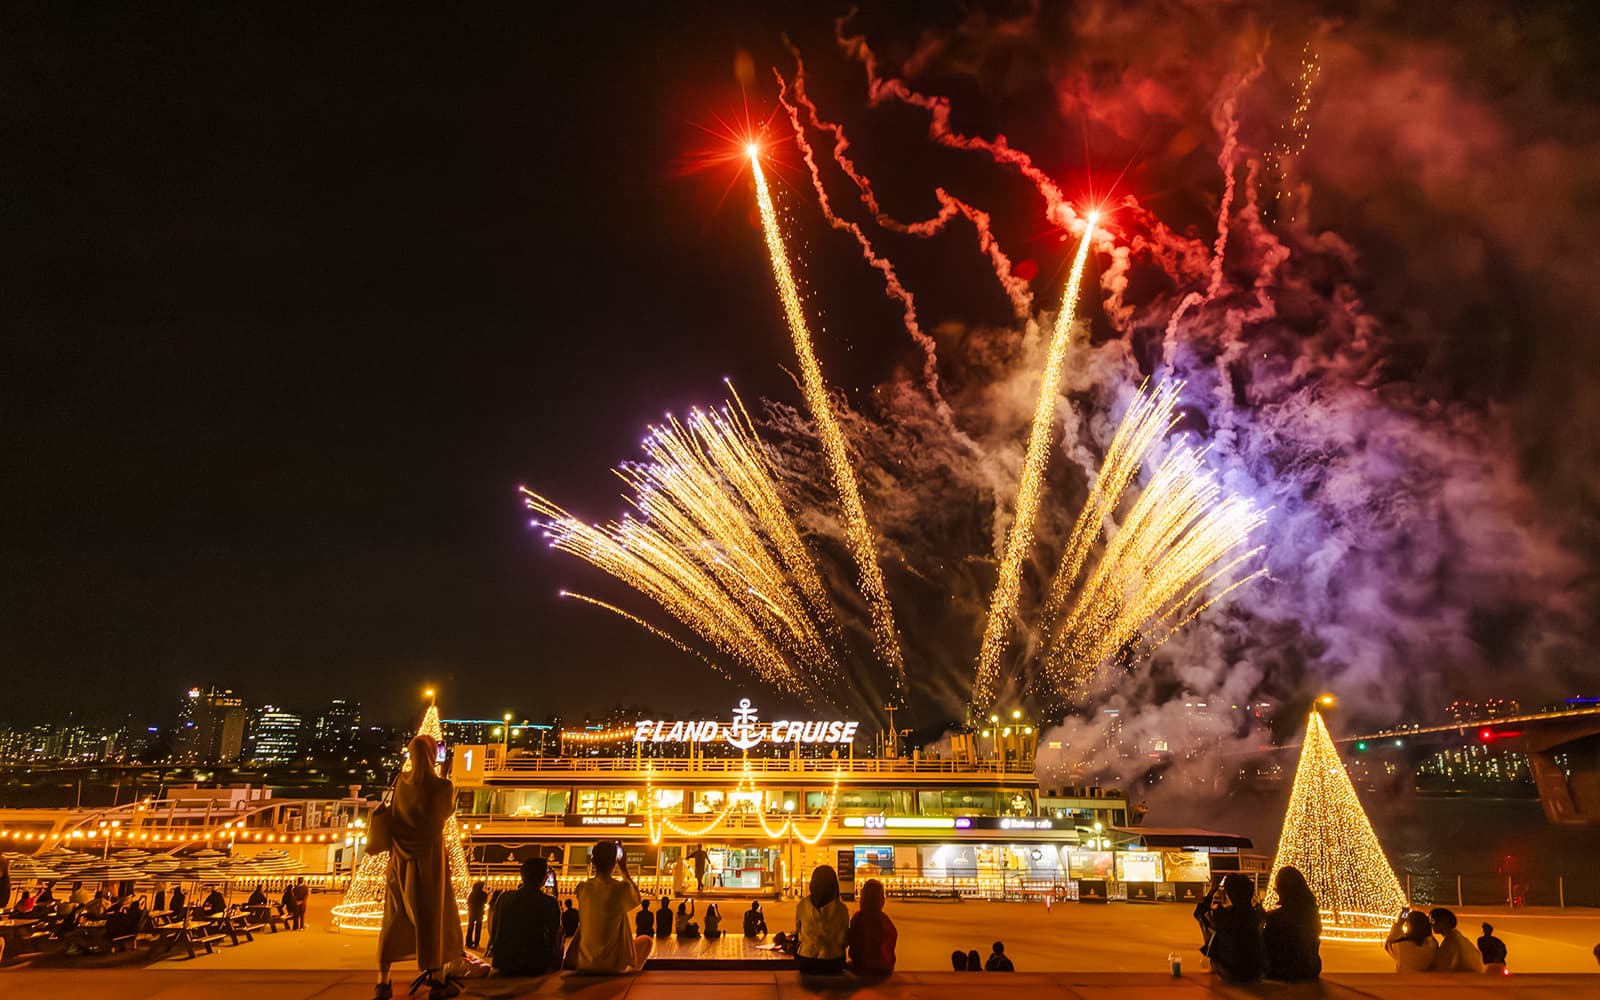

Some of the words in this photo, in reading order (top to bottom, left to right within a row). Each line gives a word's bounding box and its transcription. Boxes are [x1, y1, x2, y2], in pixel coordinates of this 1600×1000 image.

[772, 720, 859, 742] CRUISE
[464, 749, 473, 771] 1
[865, 816, 885, 828] CU
